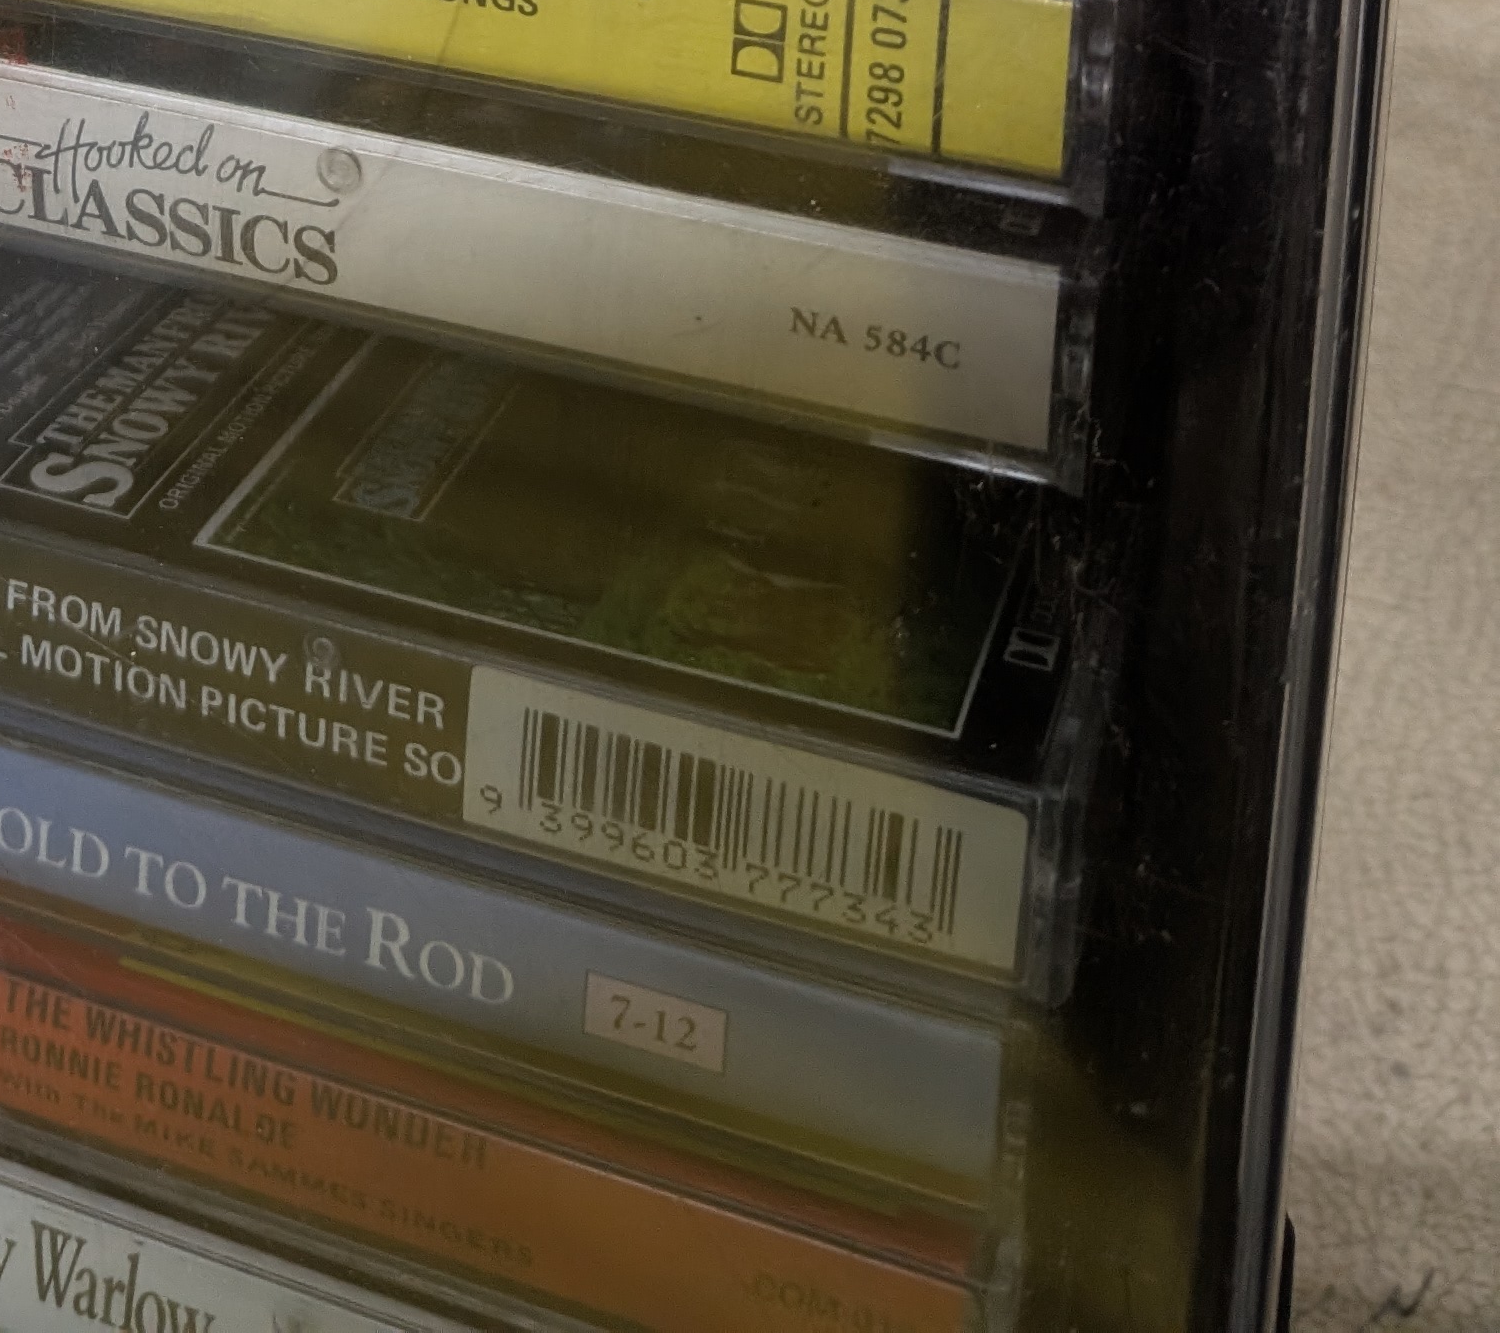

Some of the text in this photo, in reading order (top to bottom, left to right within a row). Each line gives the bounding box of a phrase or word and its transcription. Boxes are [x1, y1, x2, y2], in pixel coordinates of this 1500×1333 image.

[788, 308, 962, 370] NA 584C
[6, 580, 121, 637] FROM
[135, 615, 287, 683] SNOWY
[304, 662, 445, 729] RIVER
[20, 635, 187, 709] MOTION
[201, 687, 388, 766] PICTURE
[479, 782, 502, 815] 9
[125, 845, 206, 909] TO
[220, 876, 346, 956] THE
[366, 906, 514, 1004] ROD
[5, 980, 70, 1030] THE
[610, 994, 697, 1055] 7-12
